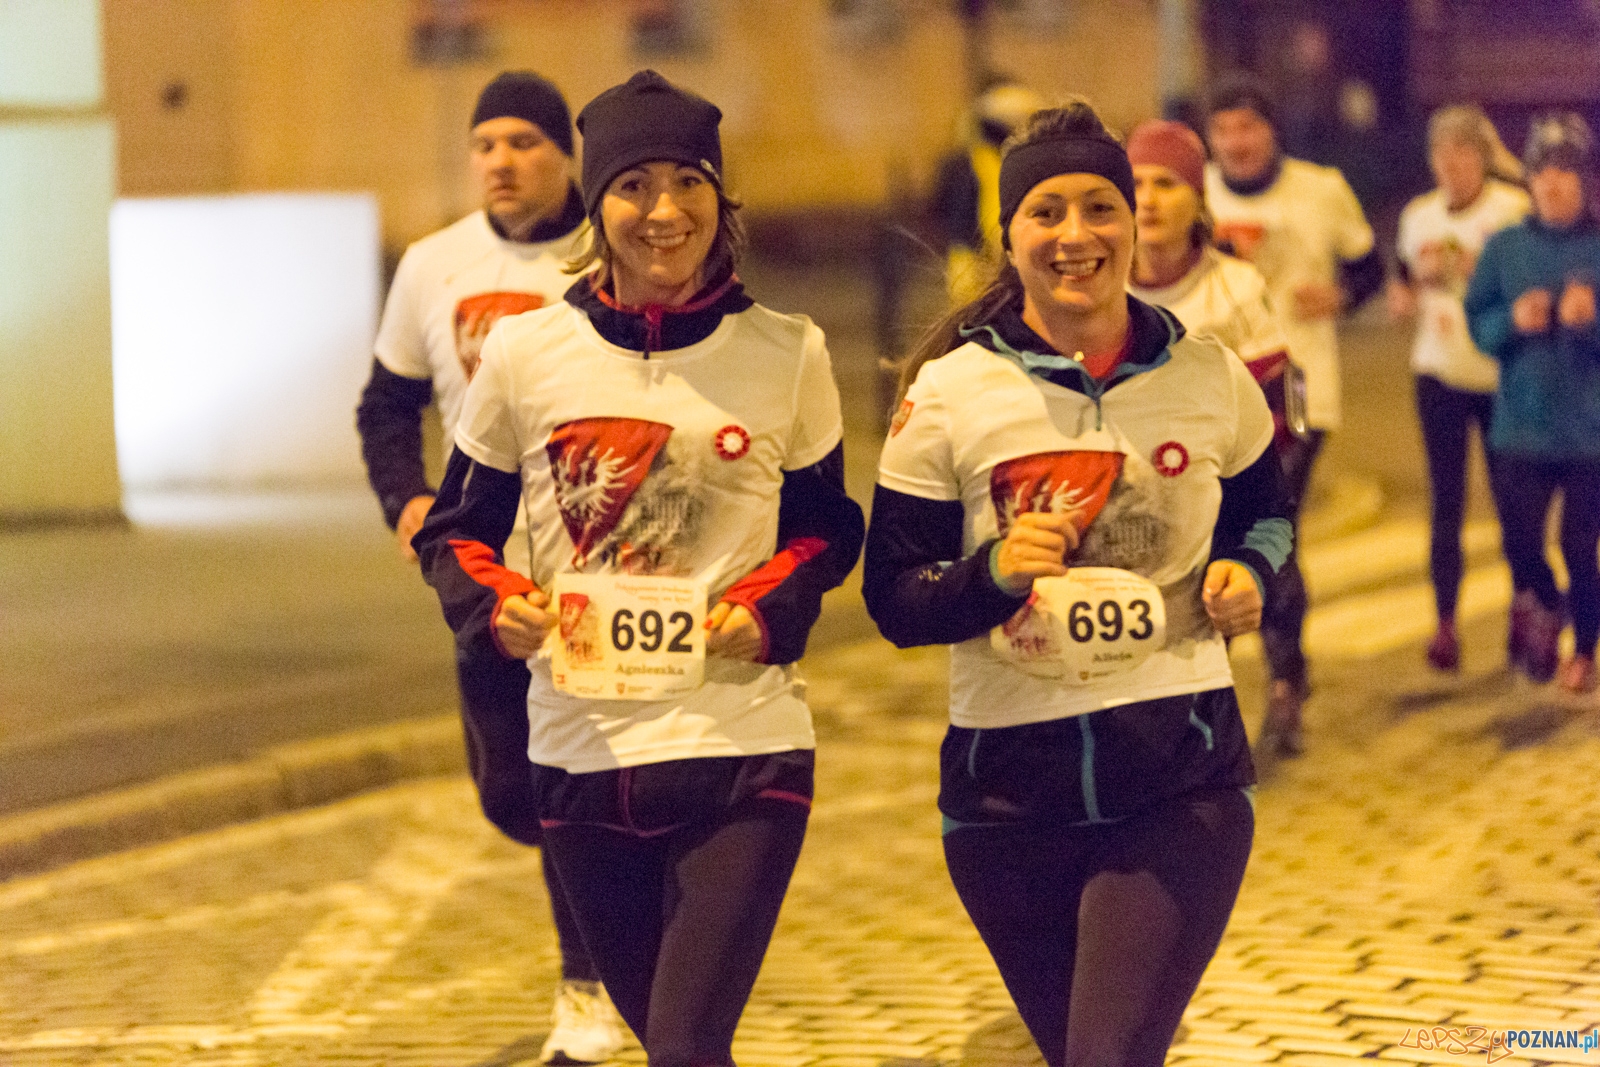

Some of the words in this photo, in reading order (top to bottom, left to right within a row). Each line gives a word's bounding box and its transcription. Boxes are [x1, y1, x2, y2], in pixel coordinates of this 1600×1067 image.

[611, 609, 694, 653] 692
[1068, 599, 1154, 643] 693
[614, 663, 685, 676] Agnieszka
